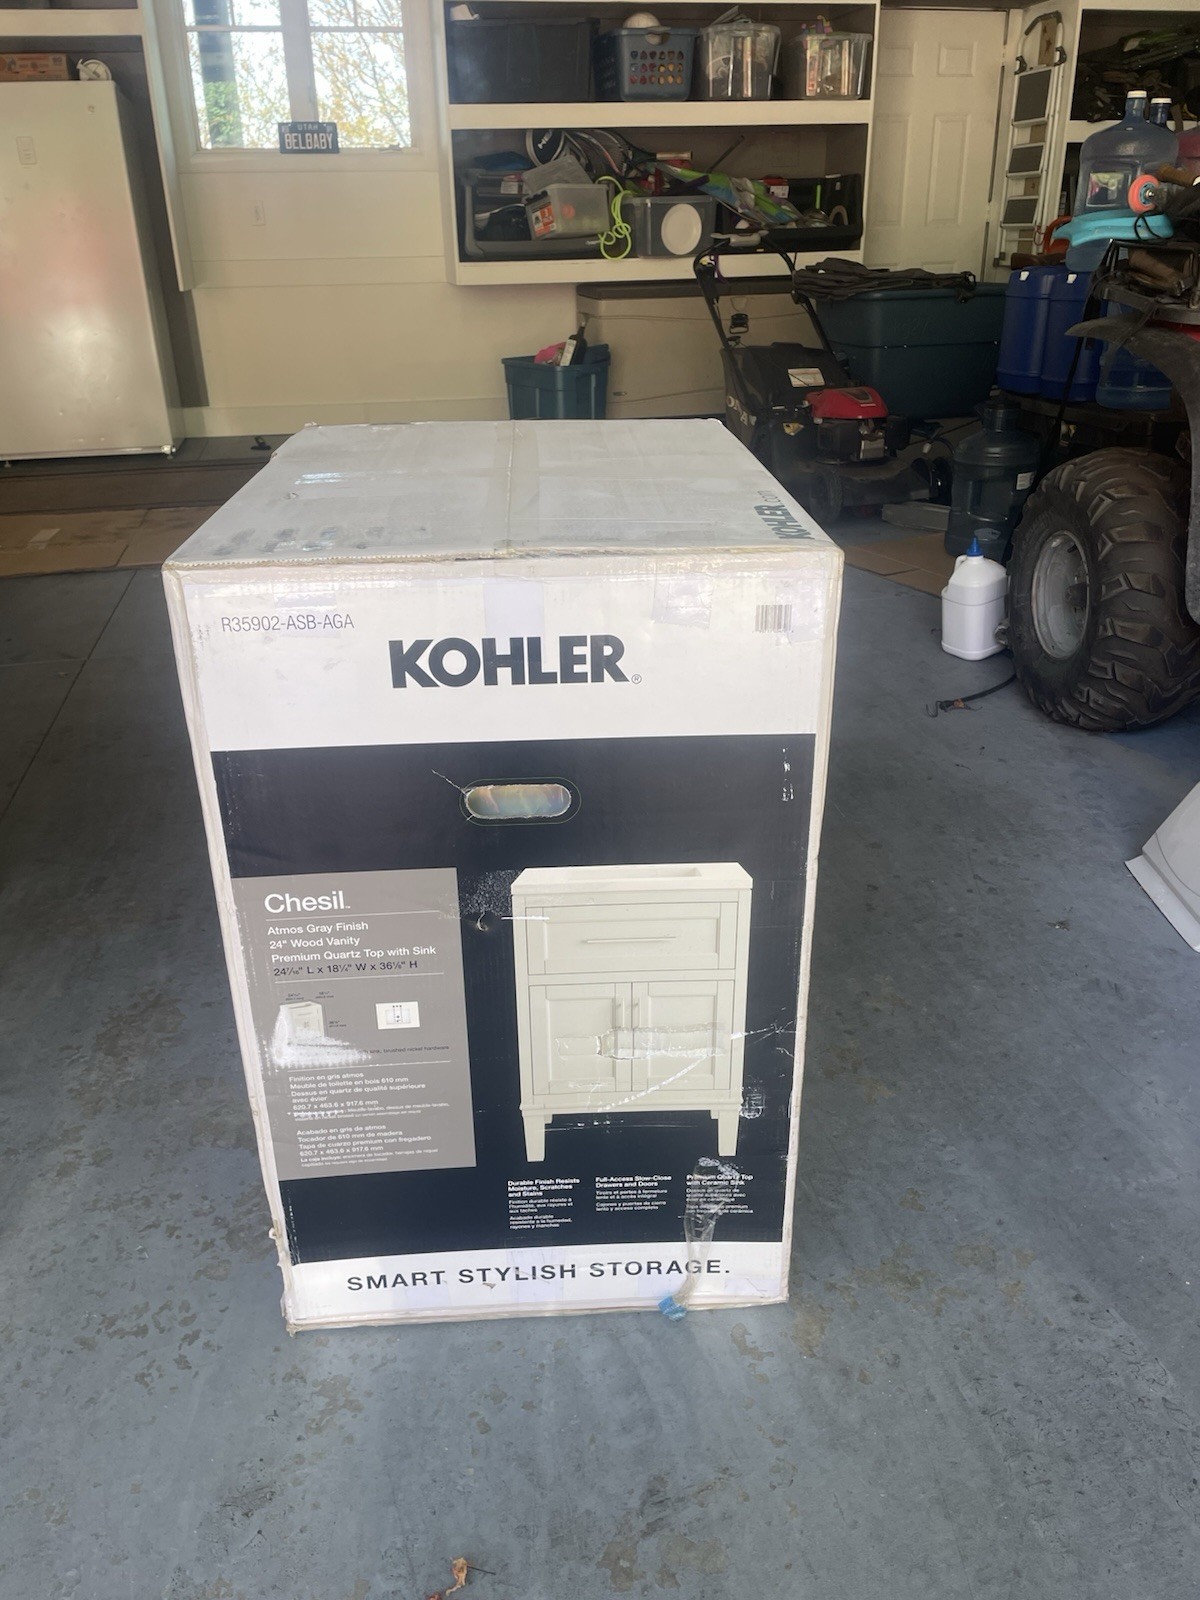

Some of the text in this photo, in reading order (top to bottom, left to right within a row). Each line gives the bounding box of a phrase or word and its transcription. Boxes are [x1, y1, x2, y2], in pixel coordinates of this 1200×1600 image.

[284, 132, 332, 150] BELBABY
[222, 614, 354, 632] R35902-ASB-AGA
[388, 634, 630, 688] KOHLER
[264, 890, 344, 913] Chesil
[268, 922, 369, 936] Atmos Gray Finish
[270, 936, 360, 949] 24" Wood Vanity
[272, 946, 436, 963] Premium Quartz Top with Sink
[307, 966, 314, 974] L
[355, 963, 366, 971] W
[410, 960, 418, 969] H
[347, 1260, 730, 1291] SMART STYLISH STORAGE.
